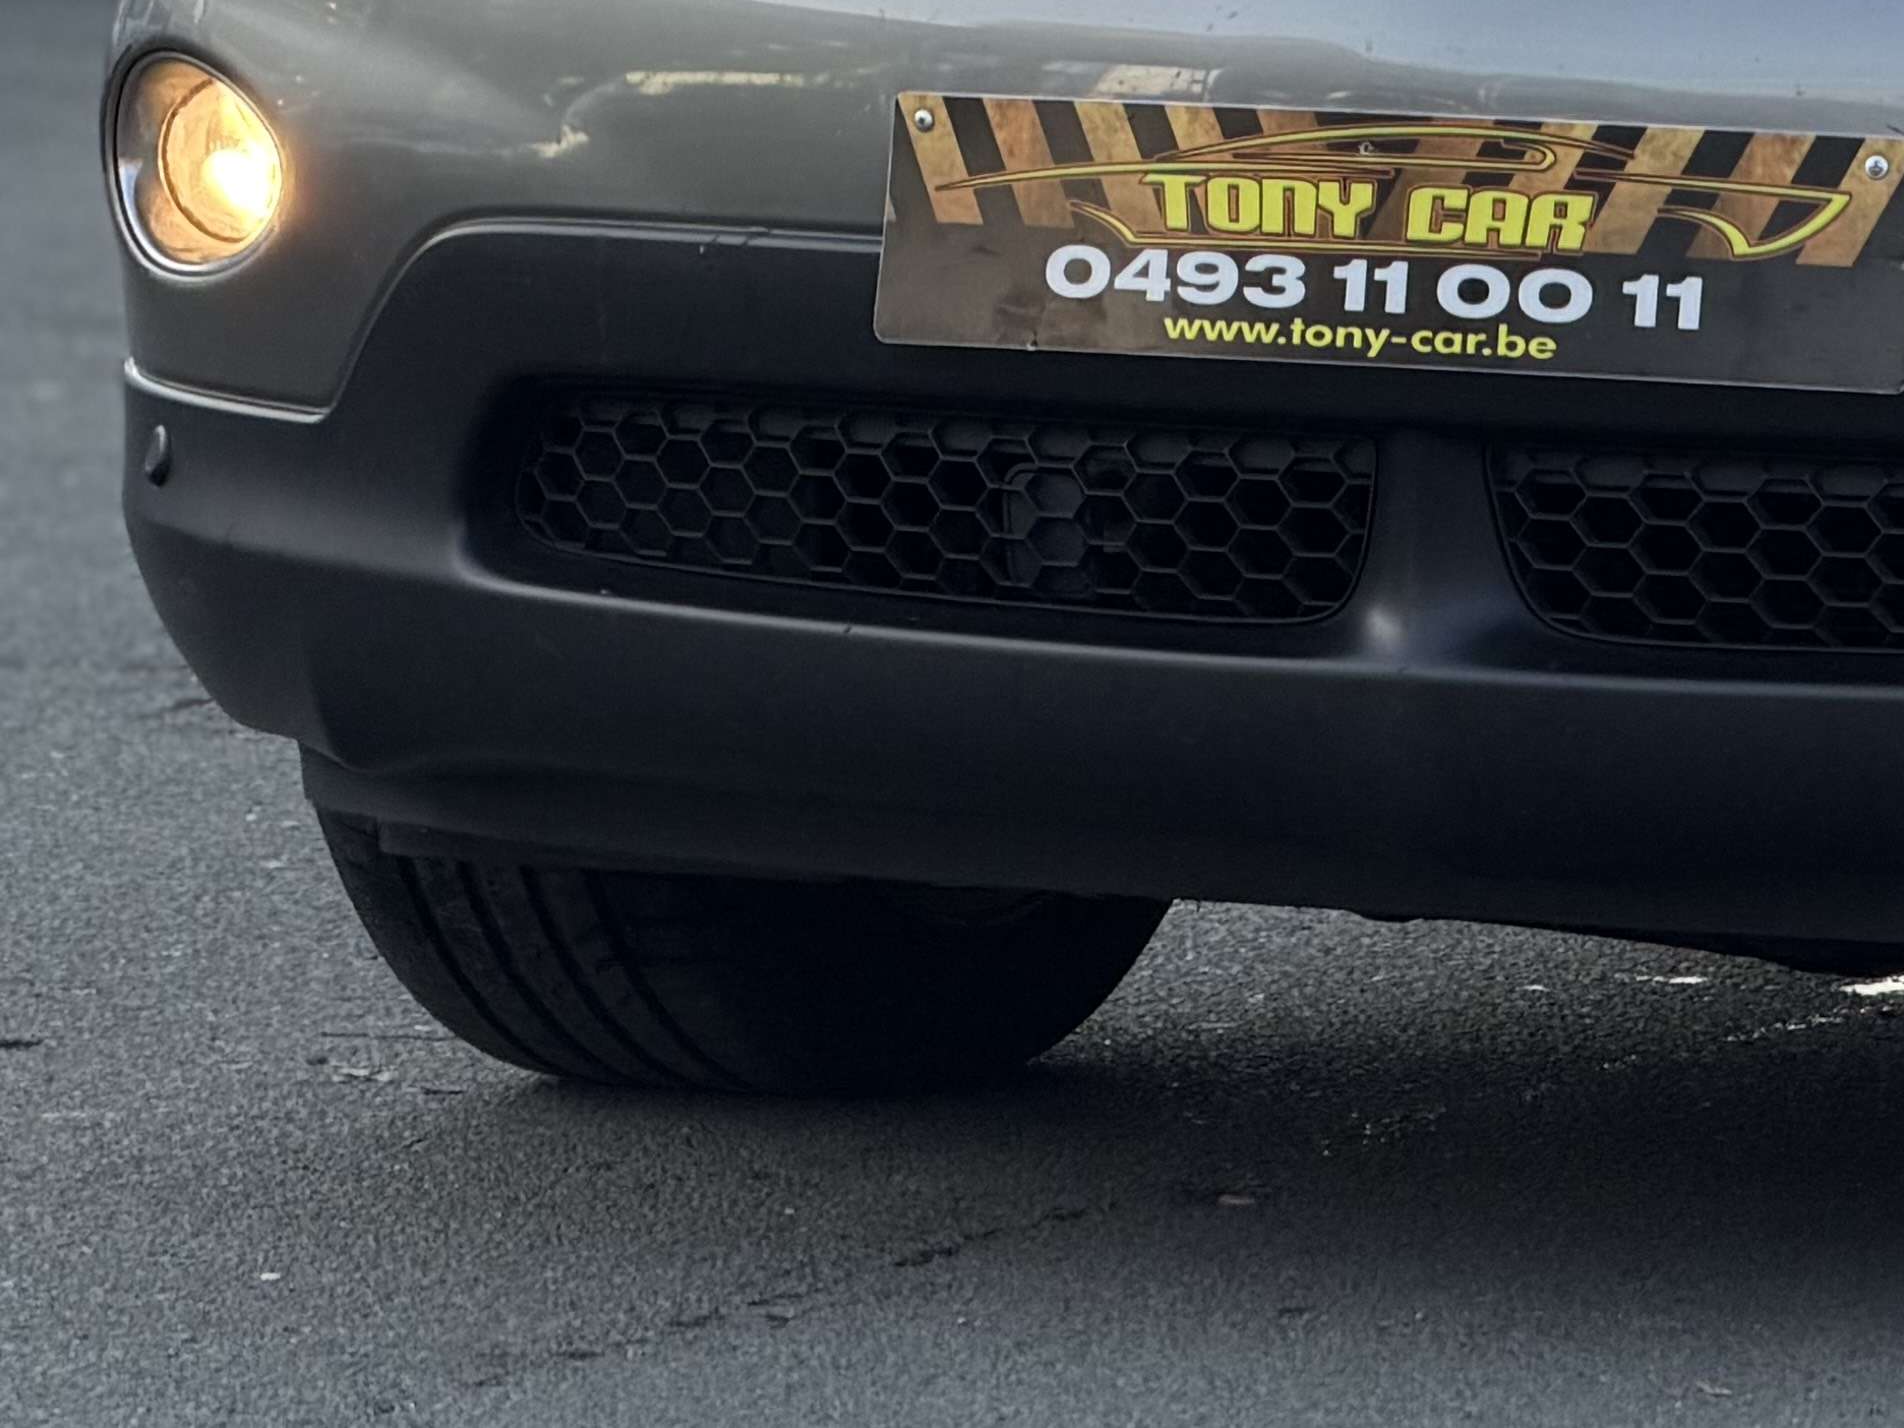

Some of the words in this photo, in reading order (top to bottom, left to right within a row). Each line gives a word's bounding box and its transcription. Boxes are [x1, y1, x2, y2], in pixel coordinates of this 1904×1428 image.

[1141, 172, 1375, 239] TONY
[1405, 186, 1596, 251] CAR
[1045, 244, 1306, 309] 0493
[1333, 258, 1409, 315] 11
[1436, 263, 1594, 324] 00
[1621, 273, 1704, 331] 11
[1163, 316, 1558, 360] www.tony-car.be
